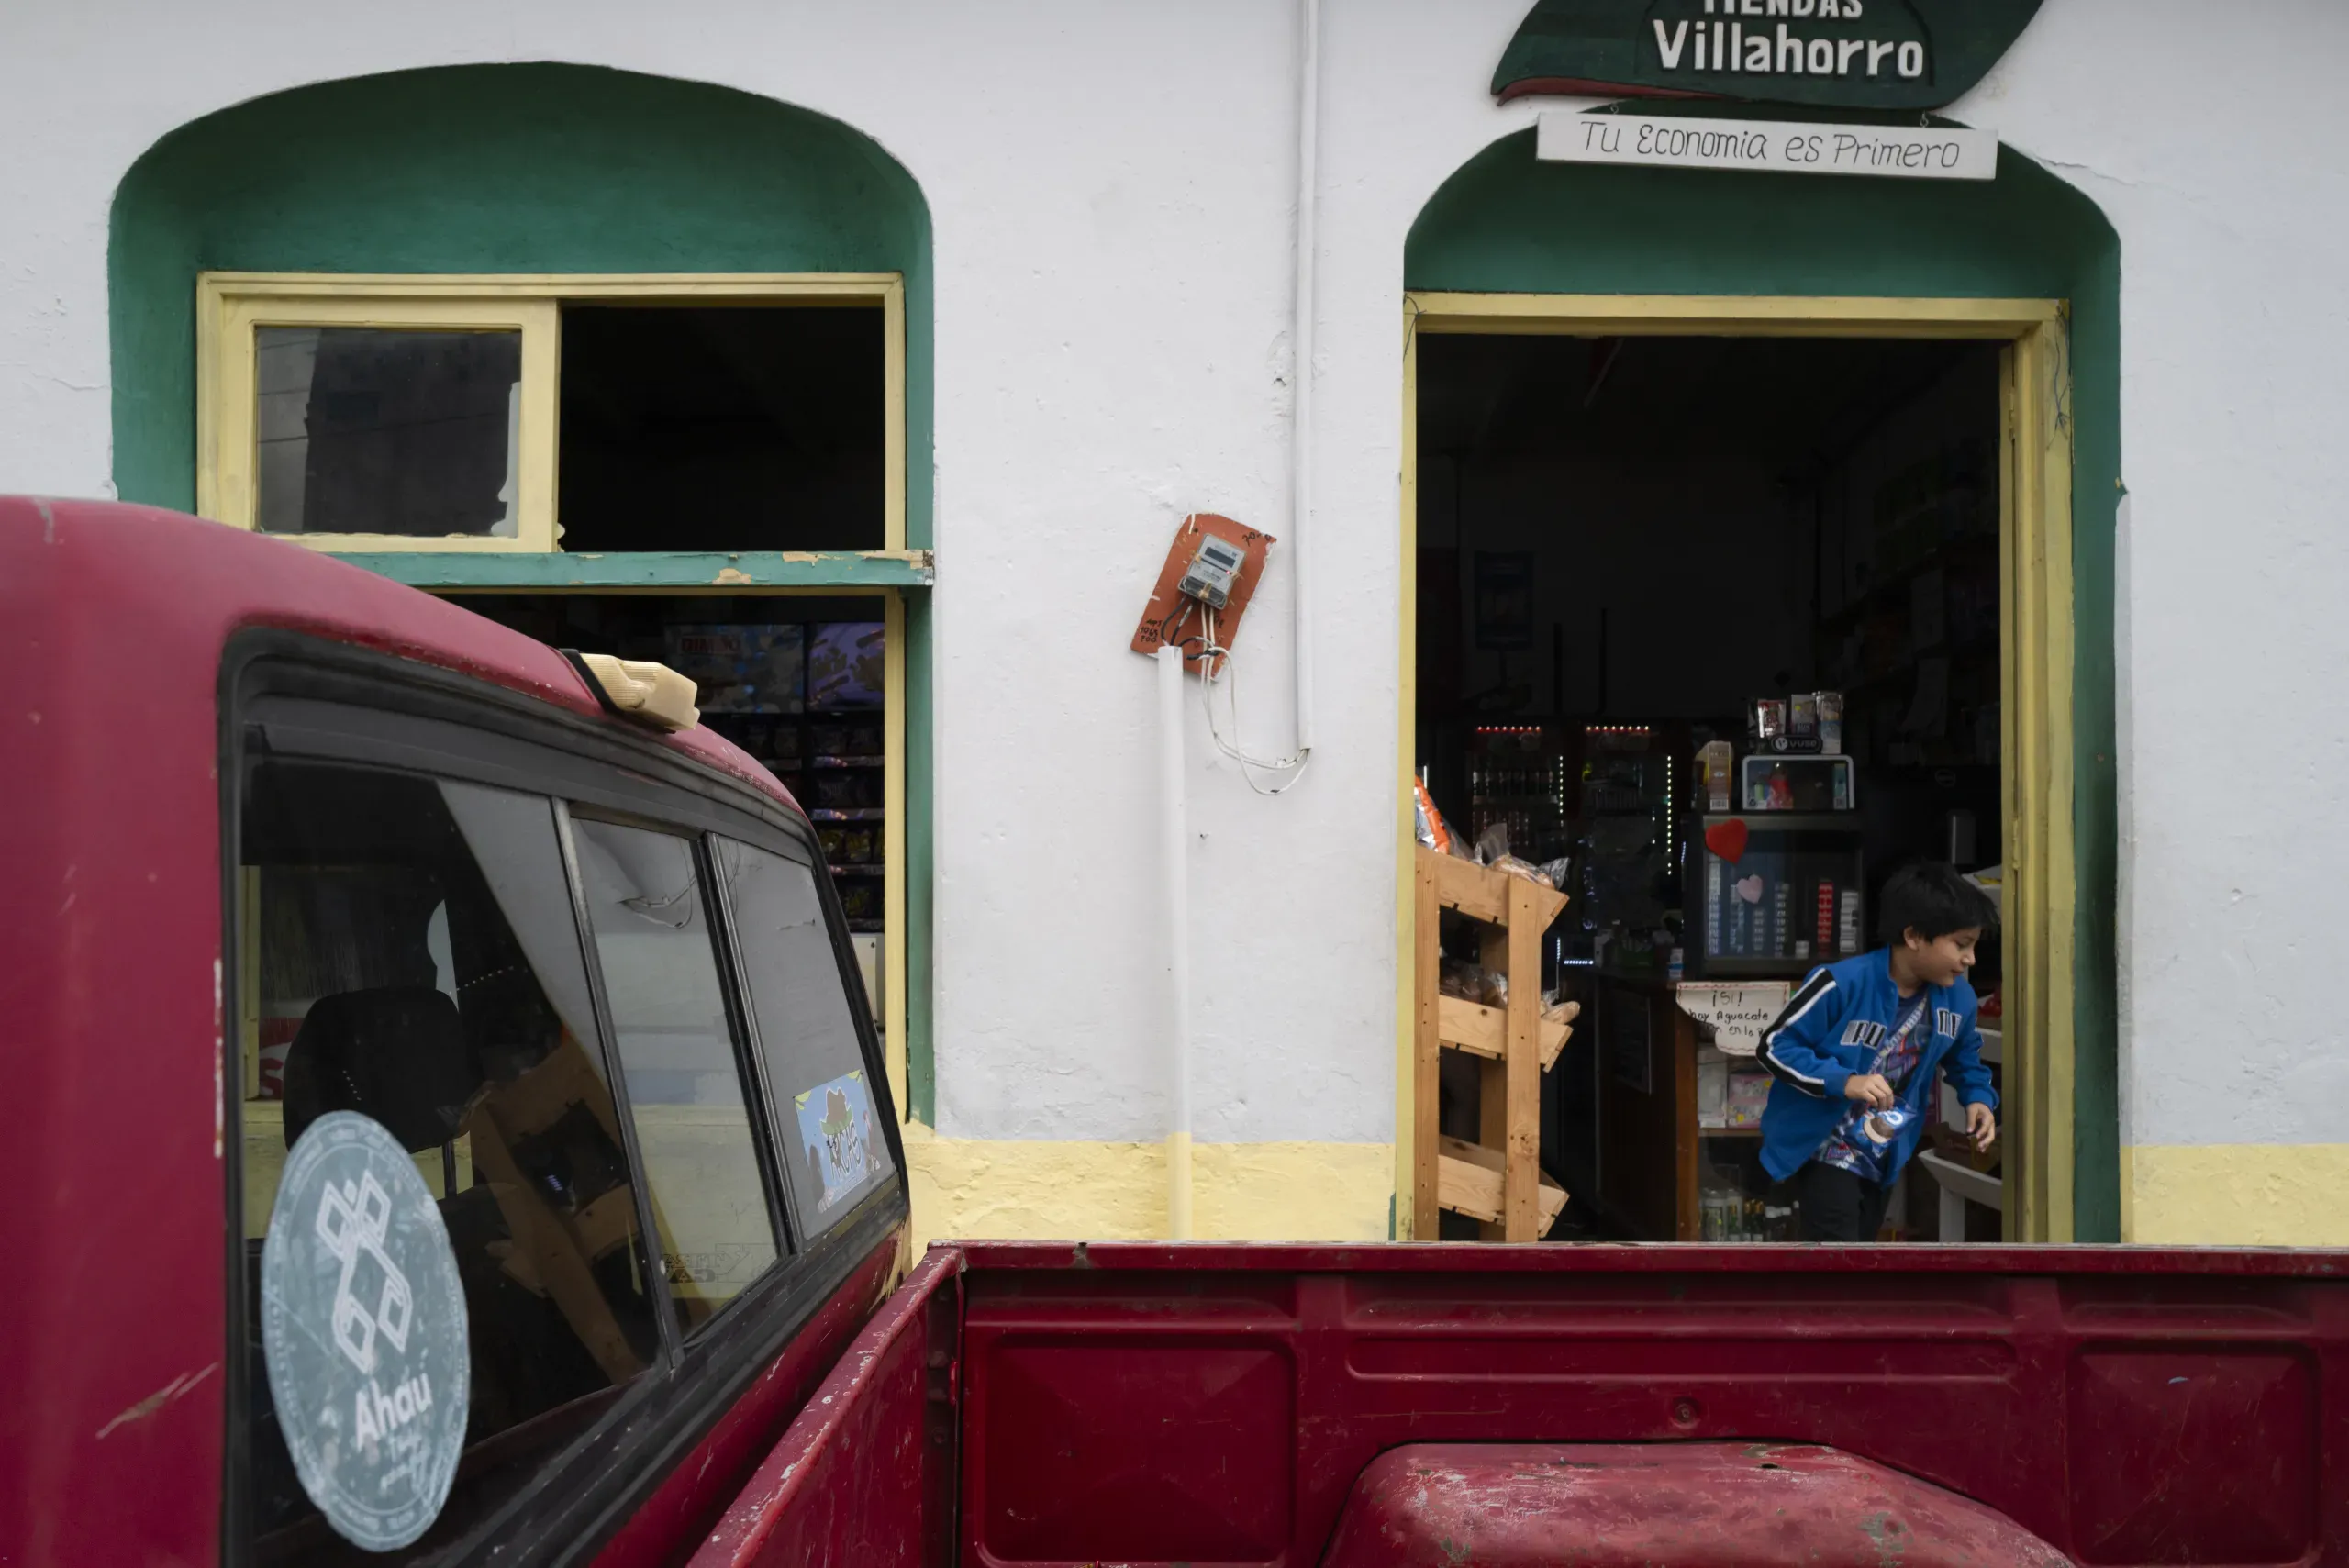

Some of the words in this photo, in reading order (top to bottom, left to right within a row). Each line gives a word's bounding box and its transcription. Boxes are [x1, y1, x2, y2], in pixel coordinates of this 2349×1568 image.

[1653, 19, 1924, 77] Villahorro
[1785, 135, 1823, 163] es
[1833, 133, 1960, 168] Primero
[1716, 1008, 1769, 1025] Aguacate
[355, 1372, 433, 1453] Ahau
